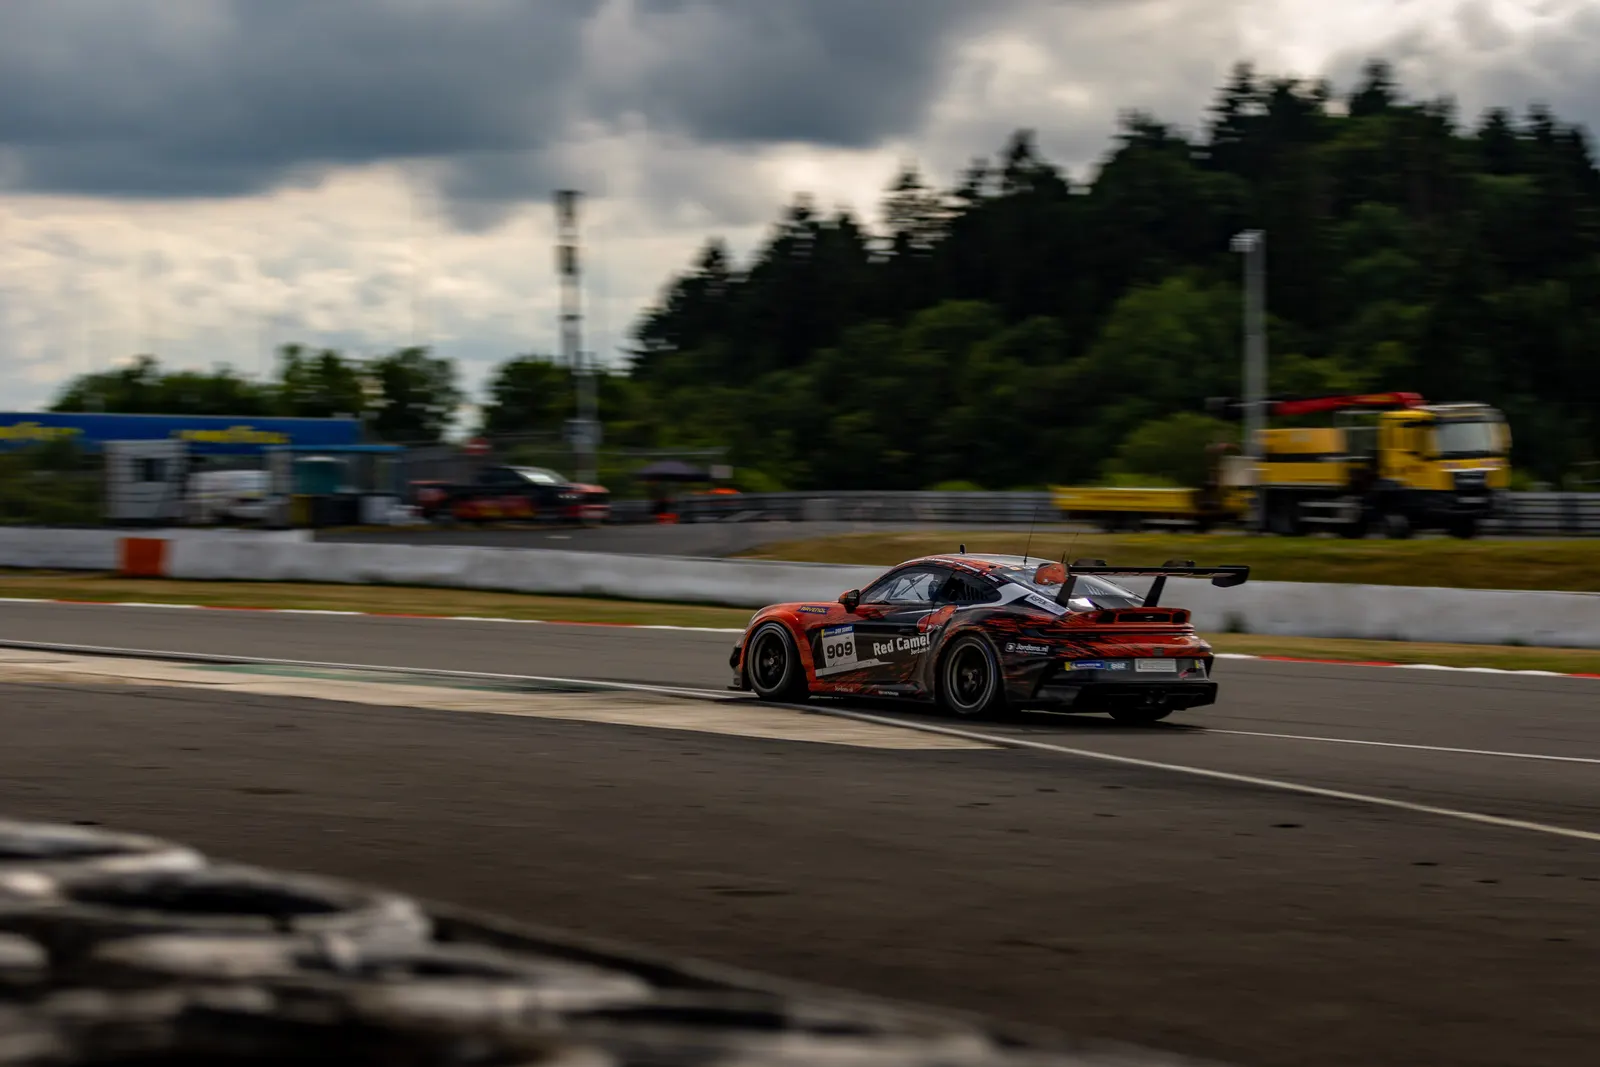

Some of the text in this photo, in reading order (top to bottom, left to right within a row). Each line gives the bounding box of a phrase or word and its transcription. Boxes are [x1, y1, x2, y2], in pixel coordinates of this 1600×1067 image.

[827, 642, 852, 659] 909
[872, 633, 930, 656] Red Camel
